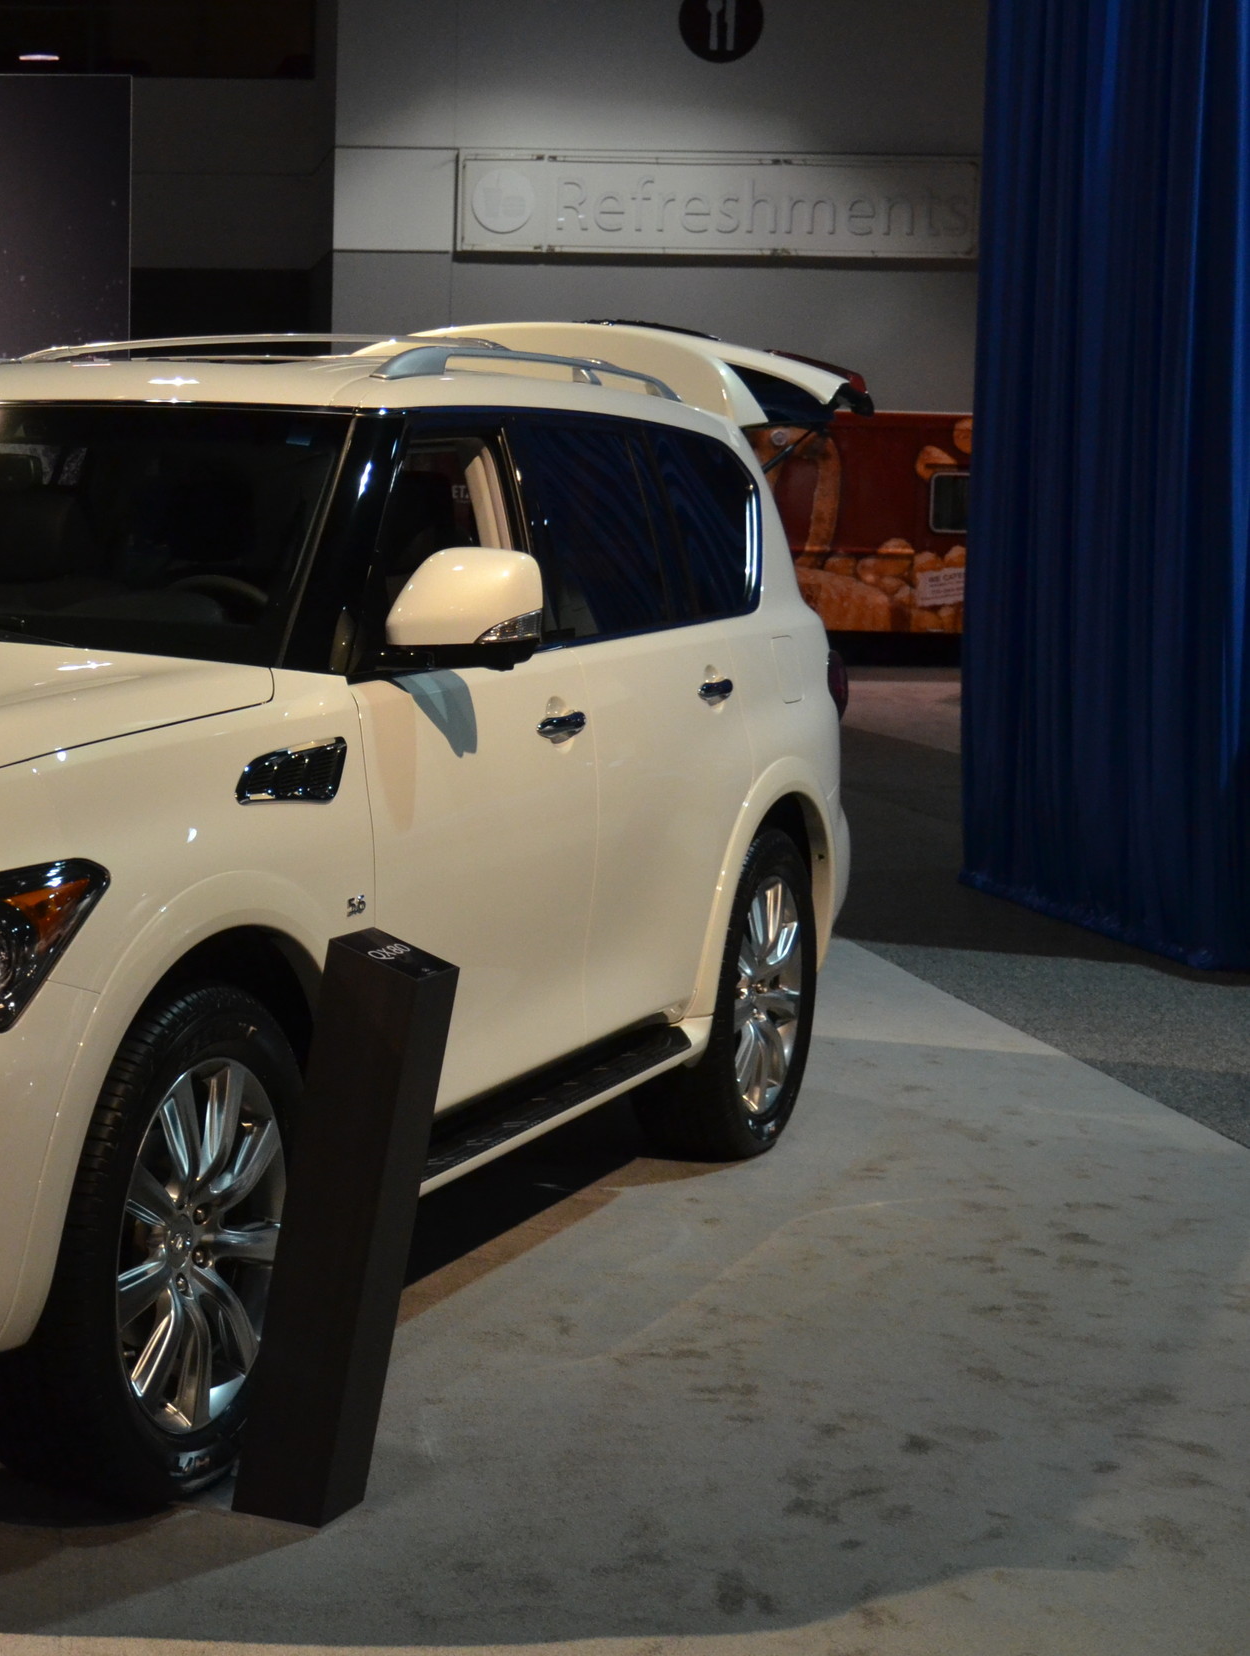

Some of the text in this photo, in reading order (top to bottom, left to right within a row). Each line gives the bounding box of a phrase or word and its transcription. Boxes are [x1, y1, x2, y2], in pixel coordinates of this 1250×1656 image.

[554, 174, 970, 238] Refreshments
[942, 572, 964, 582] CATE
[367, 943, 411, 960] QX80
